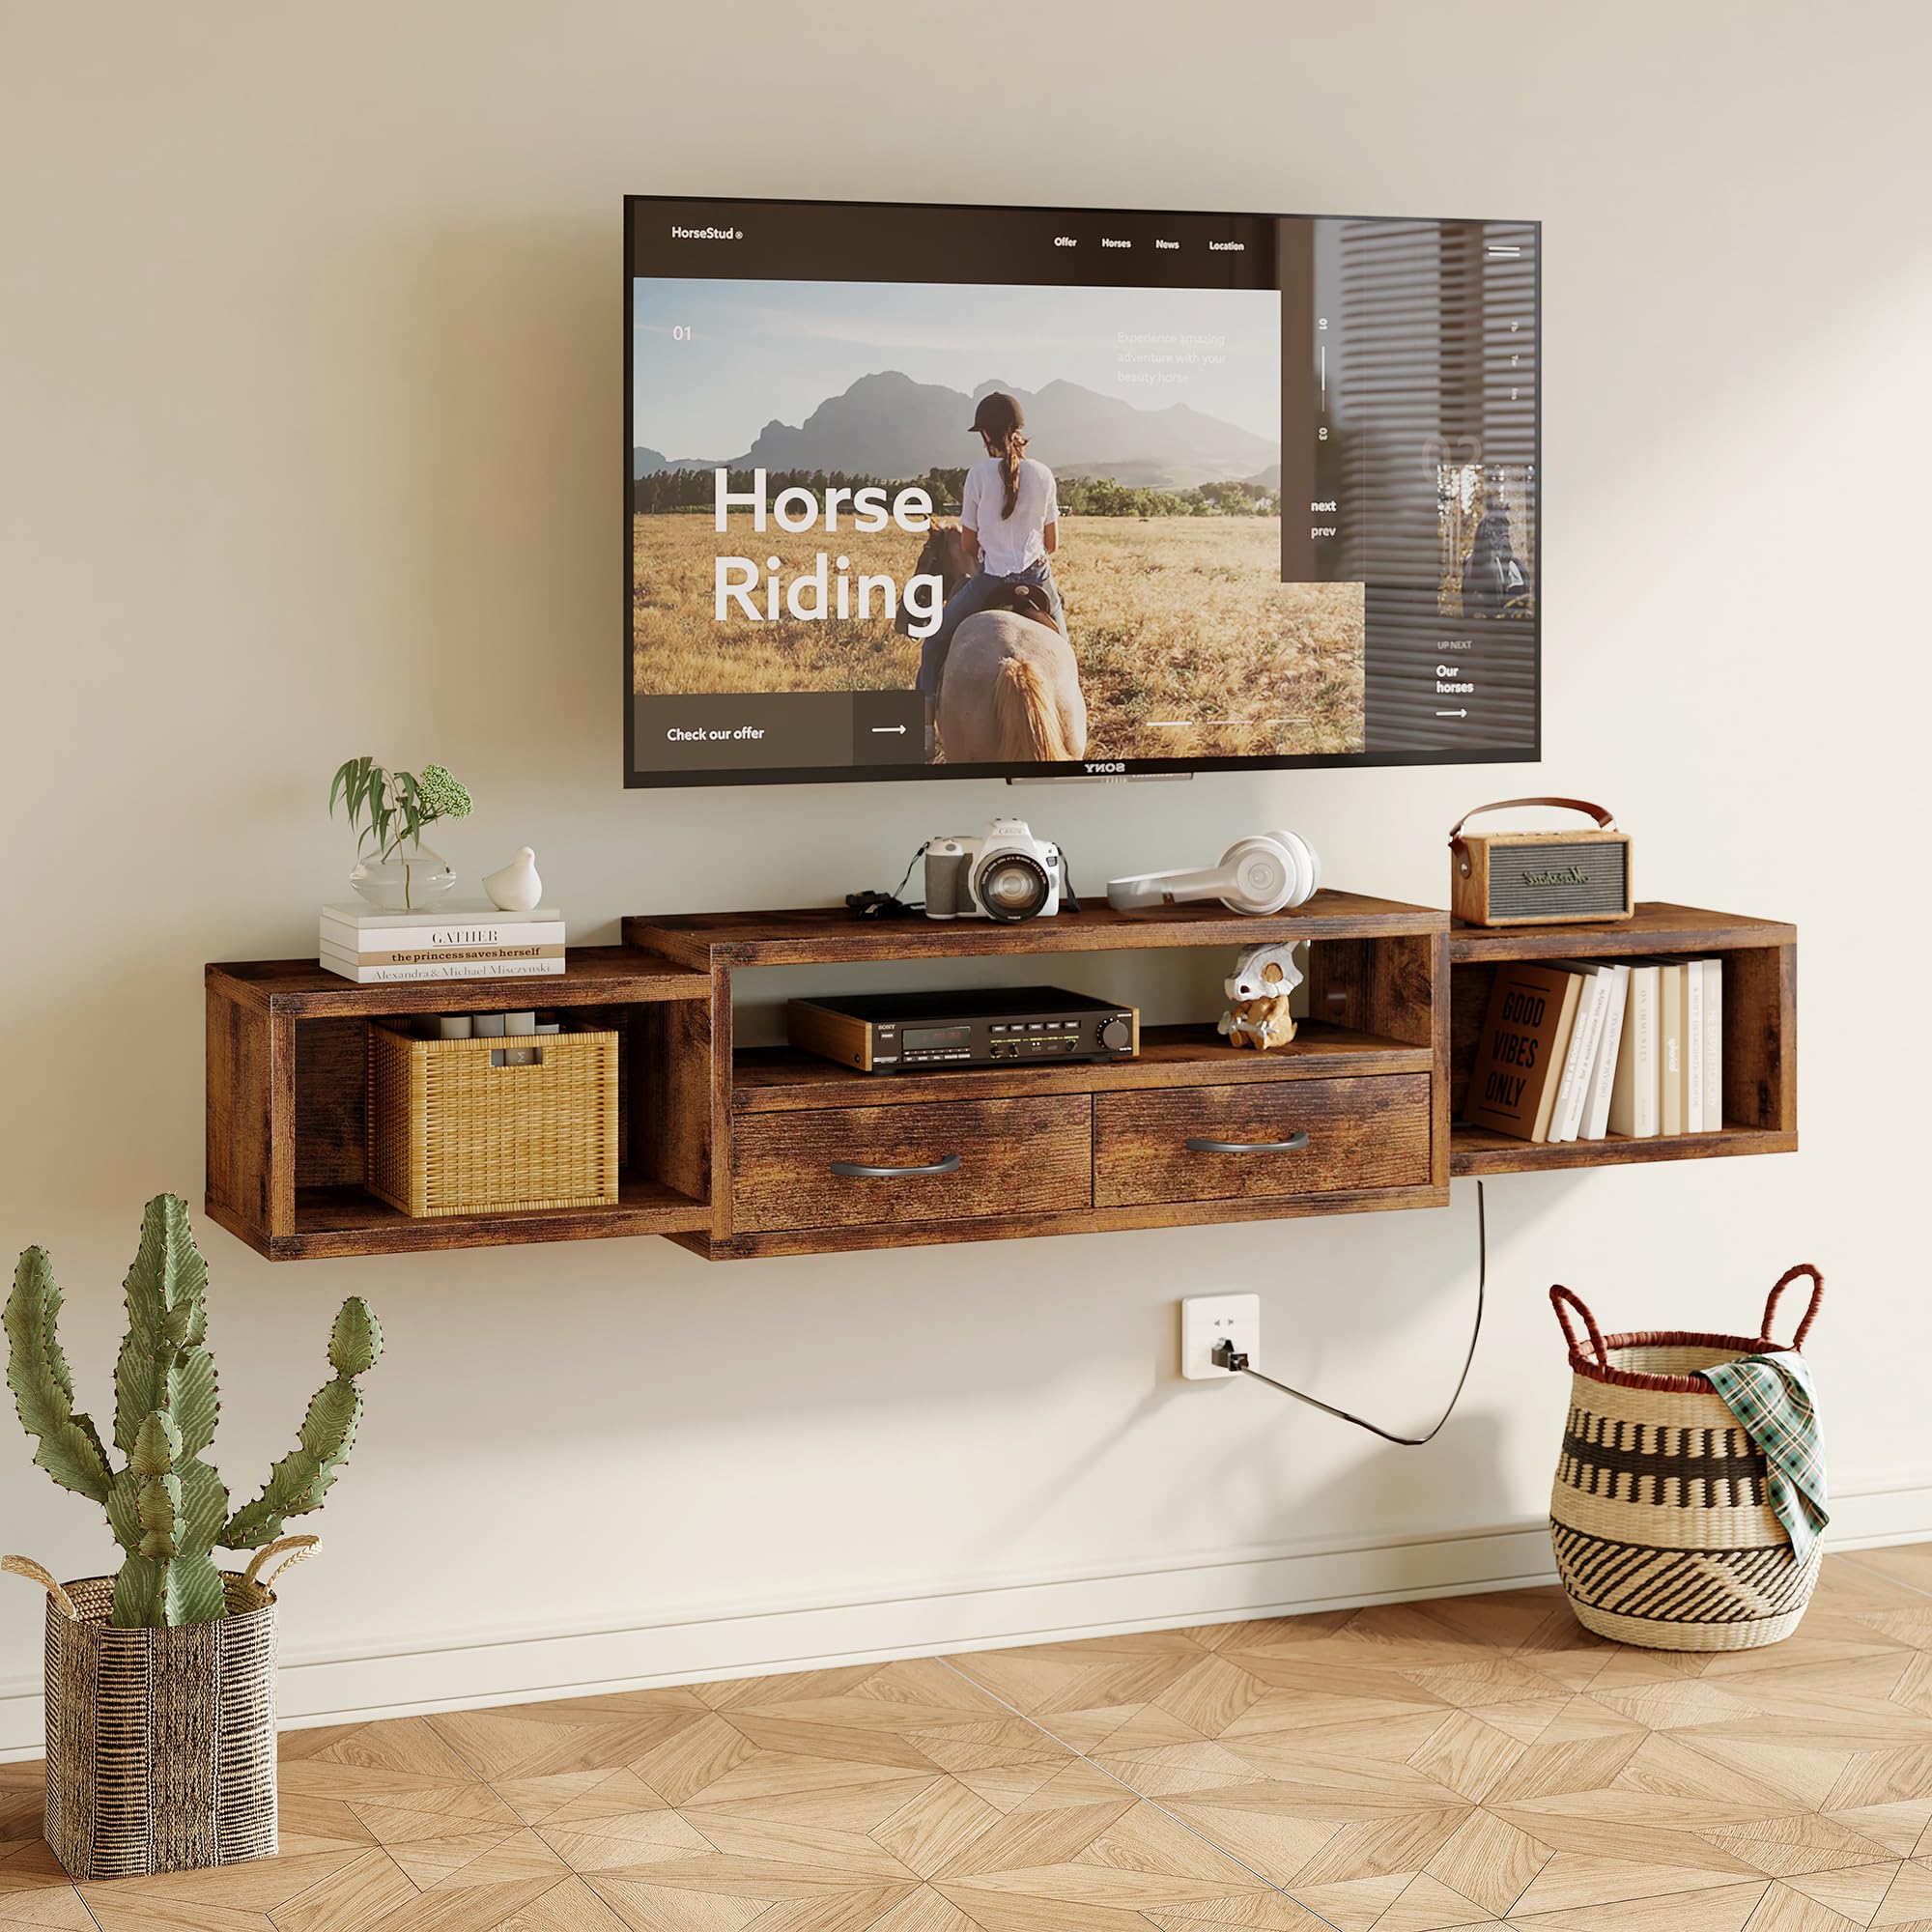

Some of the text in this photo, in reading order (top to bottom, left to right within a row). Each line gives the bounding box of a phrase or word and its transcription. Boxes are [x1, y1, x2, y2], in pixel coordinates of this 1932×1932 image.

[671, 226, 734, 240] HorseStud
[1054, 237, 1077, 247] Offer
[1101, 238, 1131, 248] Horses
[1155, 240, 1179, 250] News
[1208, 241, 1244, 251] Location
[1319, 318, 1328, 330] 01
[672, 325, 693, 341] 01
[1117, 331, 1177, 345] Experience
[1117, 352, 1227, 369] adventure with your
[1319, 427, 1328, 440] 03
[715, 468, 933, 532] Horse
[1311, 500, 1337, 512] next
[1311, 526, 1337, 539] prev
[715, 553, 944, 639] Riding
[1436, 640, 1472, 650] UP NEXT
[1435, 665, 1459, 677] Our
[1435, 681, 1474, 693] horses
[667, 726, 765, 741] Check our offer
[432, 930, 497, 944] GATHER
[391, 948, 541, 963] the princess saves herself
[374, 968, 430, 981] Alexandra
[430, 968, 440, 978] &
[441, 966, 486, 977] Michael
[1501, 992, 1546, 1027] GOOD
[1492, 1030, 1539, 1069] VIBES
[1485, 1071, 1526, 1107] ONLY
